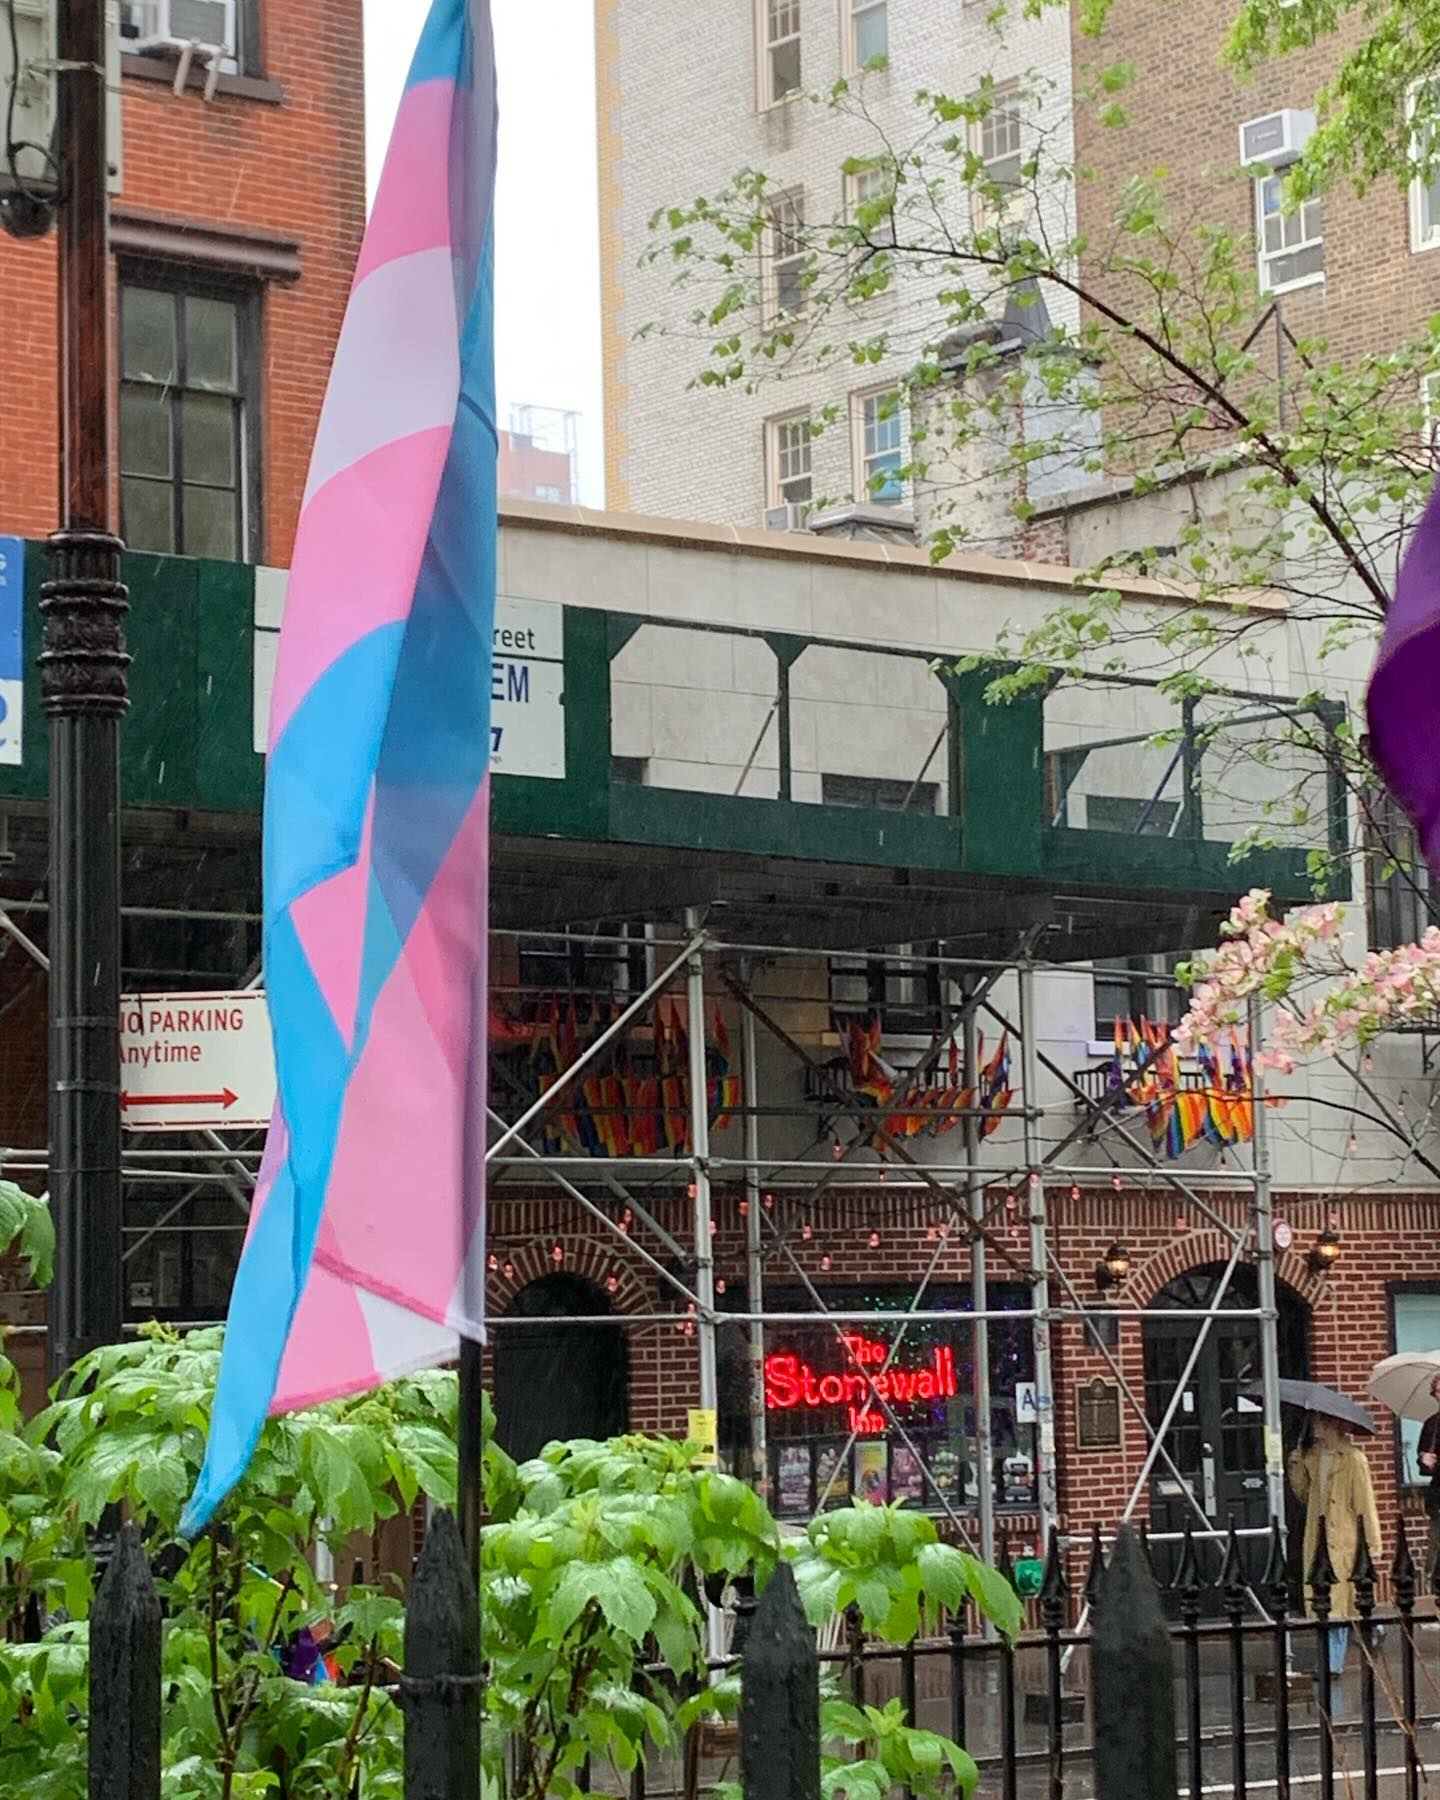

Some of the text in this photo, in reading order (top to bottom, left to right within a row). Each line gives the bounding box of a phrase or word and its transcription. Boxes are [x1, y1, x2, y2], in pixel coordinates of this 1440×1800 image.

[493, 628, 535, 650] reet
[151, 1009, 243, 1033] PARKING
[838, 1334, 886, 1364] The
[765, 1345, 956, 1408] Stonewall
[1022, 1388, 1038, 1411] A
[848, 1406, 885, 1432] Inn
